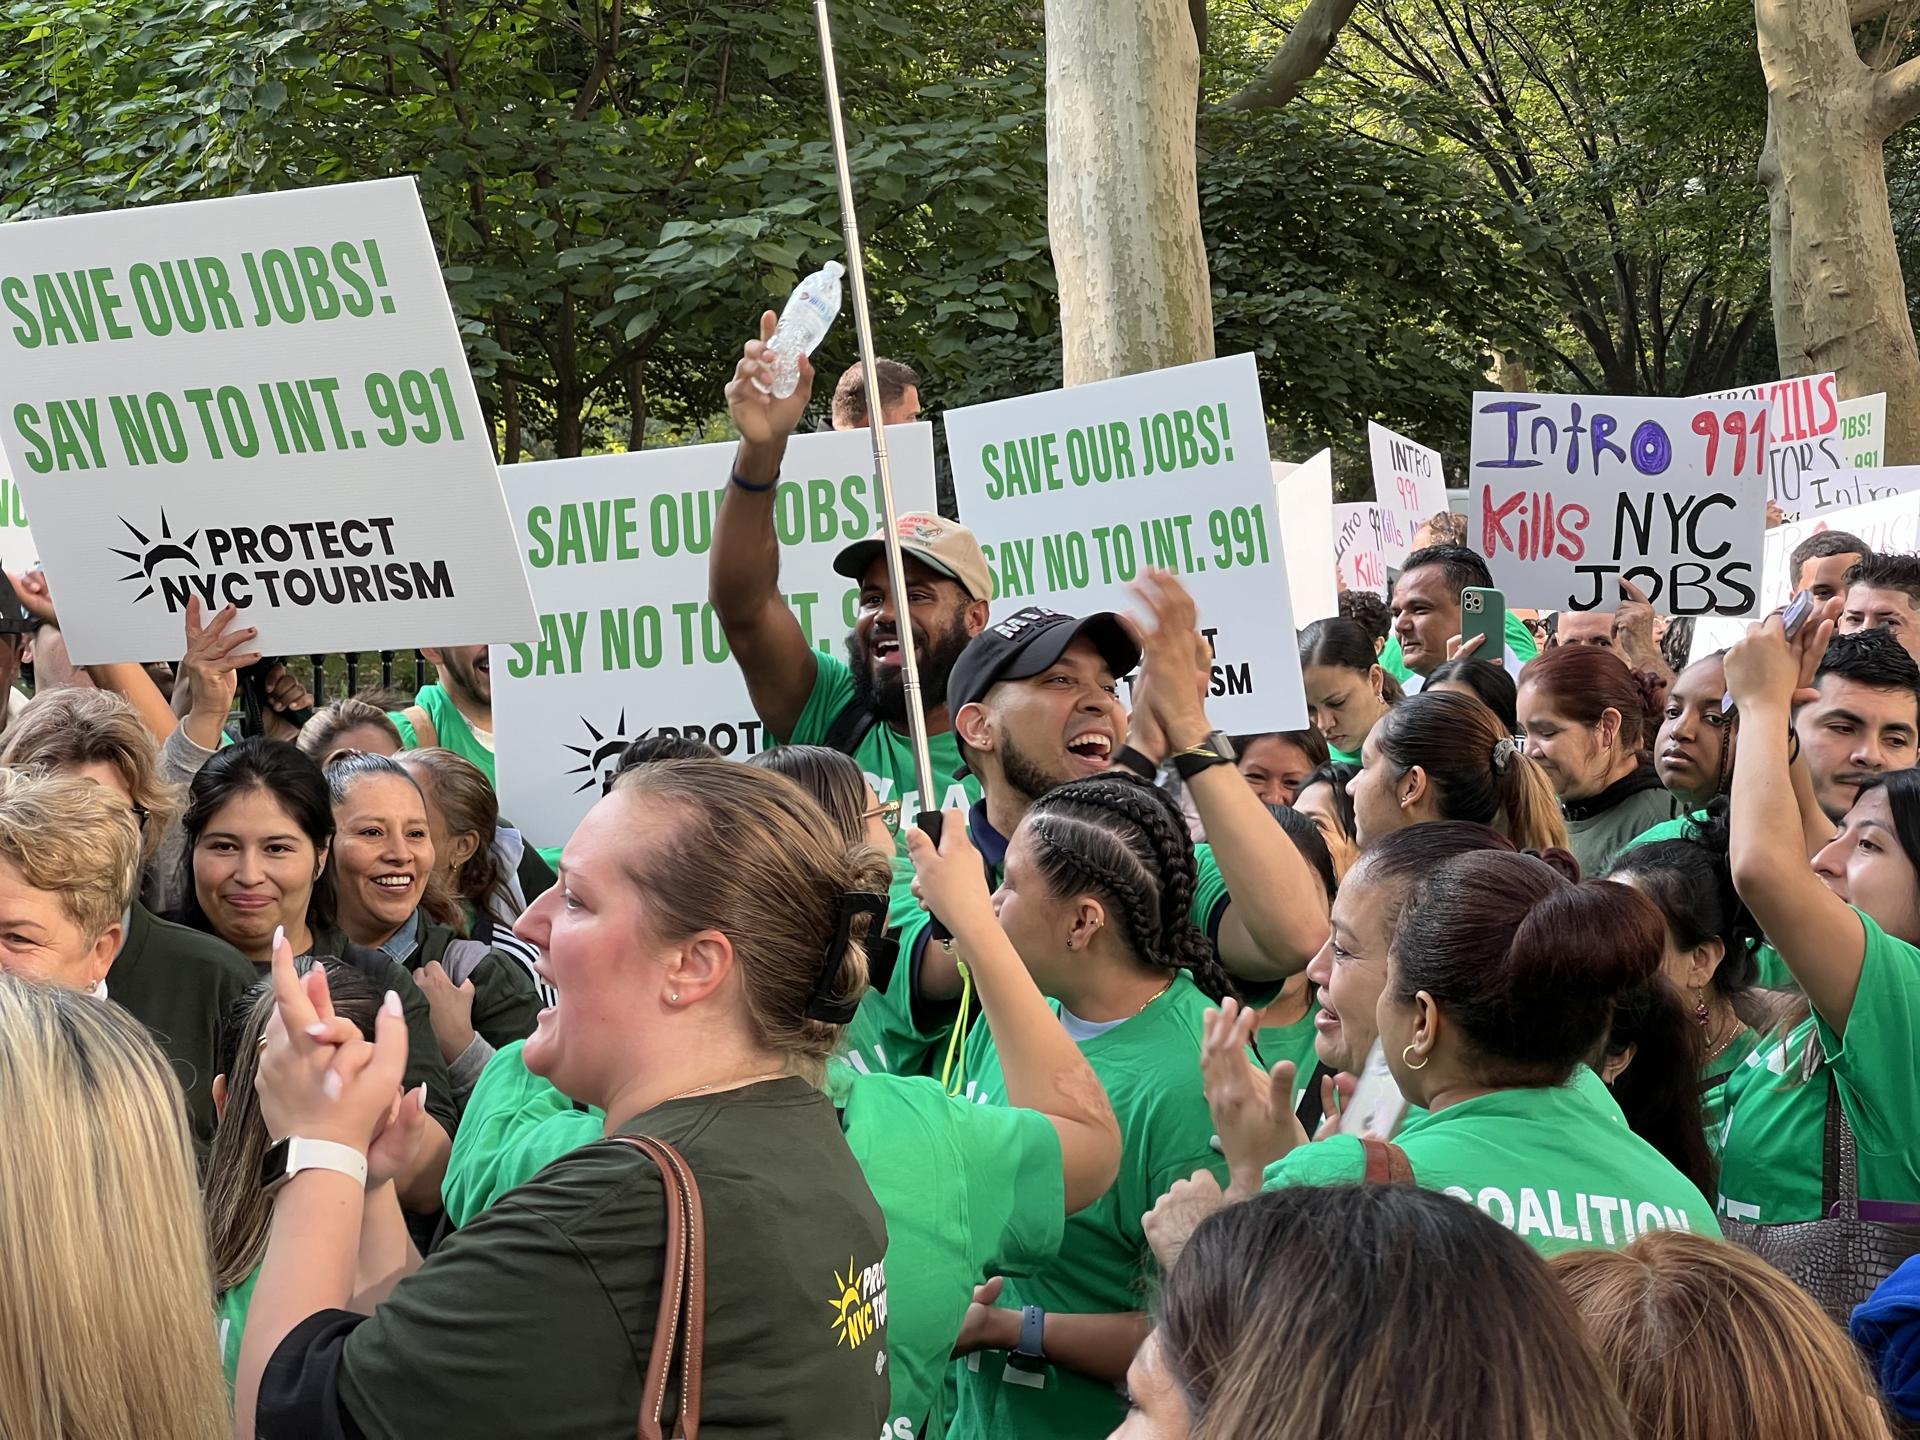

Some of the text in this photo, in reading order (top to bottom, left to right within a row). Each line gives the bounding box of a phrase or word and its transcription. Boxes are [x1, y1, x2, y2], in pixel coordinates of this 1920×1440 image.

[1, 239, 397, 349] SAVE OUR JOBS!
[14, 367, 465, 474] SAY NO TO INT. 991
[981, 403, 1234, 500] SAVE OUR JOBS!
[1691, 409, 1768, 476] 991
[1389, 440, 1431, 478] INTRO
[527, 474, 886, 568] SAVE OU OBS!
[1395, 476, 1419, 511] 991
[1482, 484, 1590, 561] Kills
[1612, 492, 1737, 560] NYC
[206, 517, 396, 566] PROTECT
[979, 503, 1271, 601] SAY NO TO INT. 991
[159, 560, 455, 613] NYC TOURISM
[1568, 562, 1756, 616] JOBS
[600, 605, 662, 671] NO
[672, 601, 732, 665] TO
[847, 1302, 873, 1350] NYC
